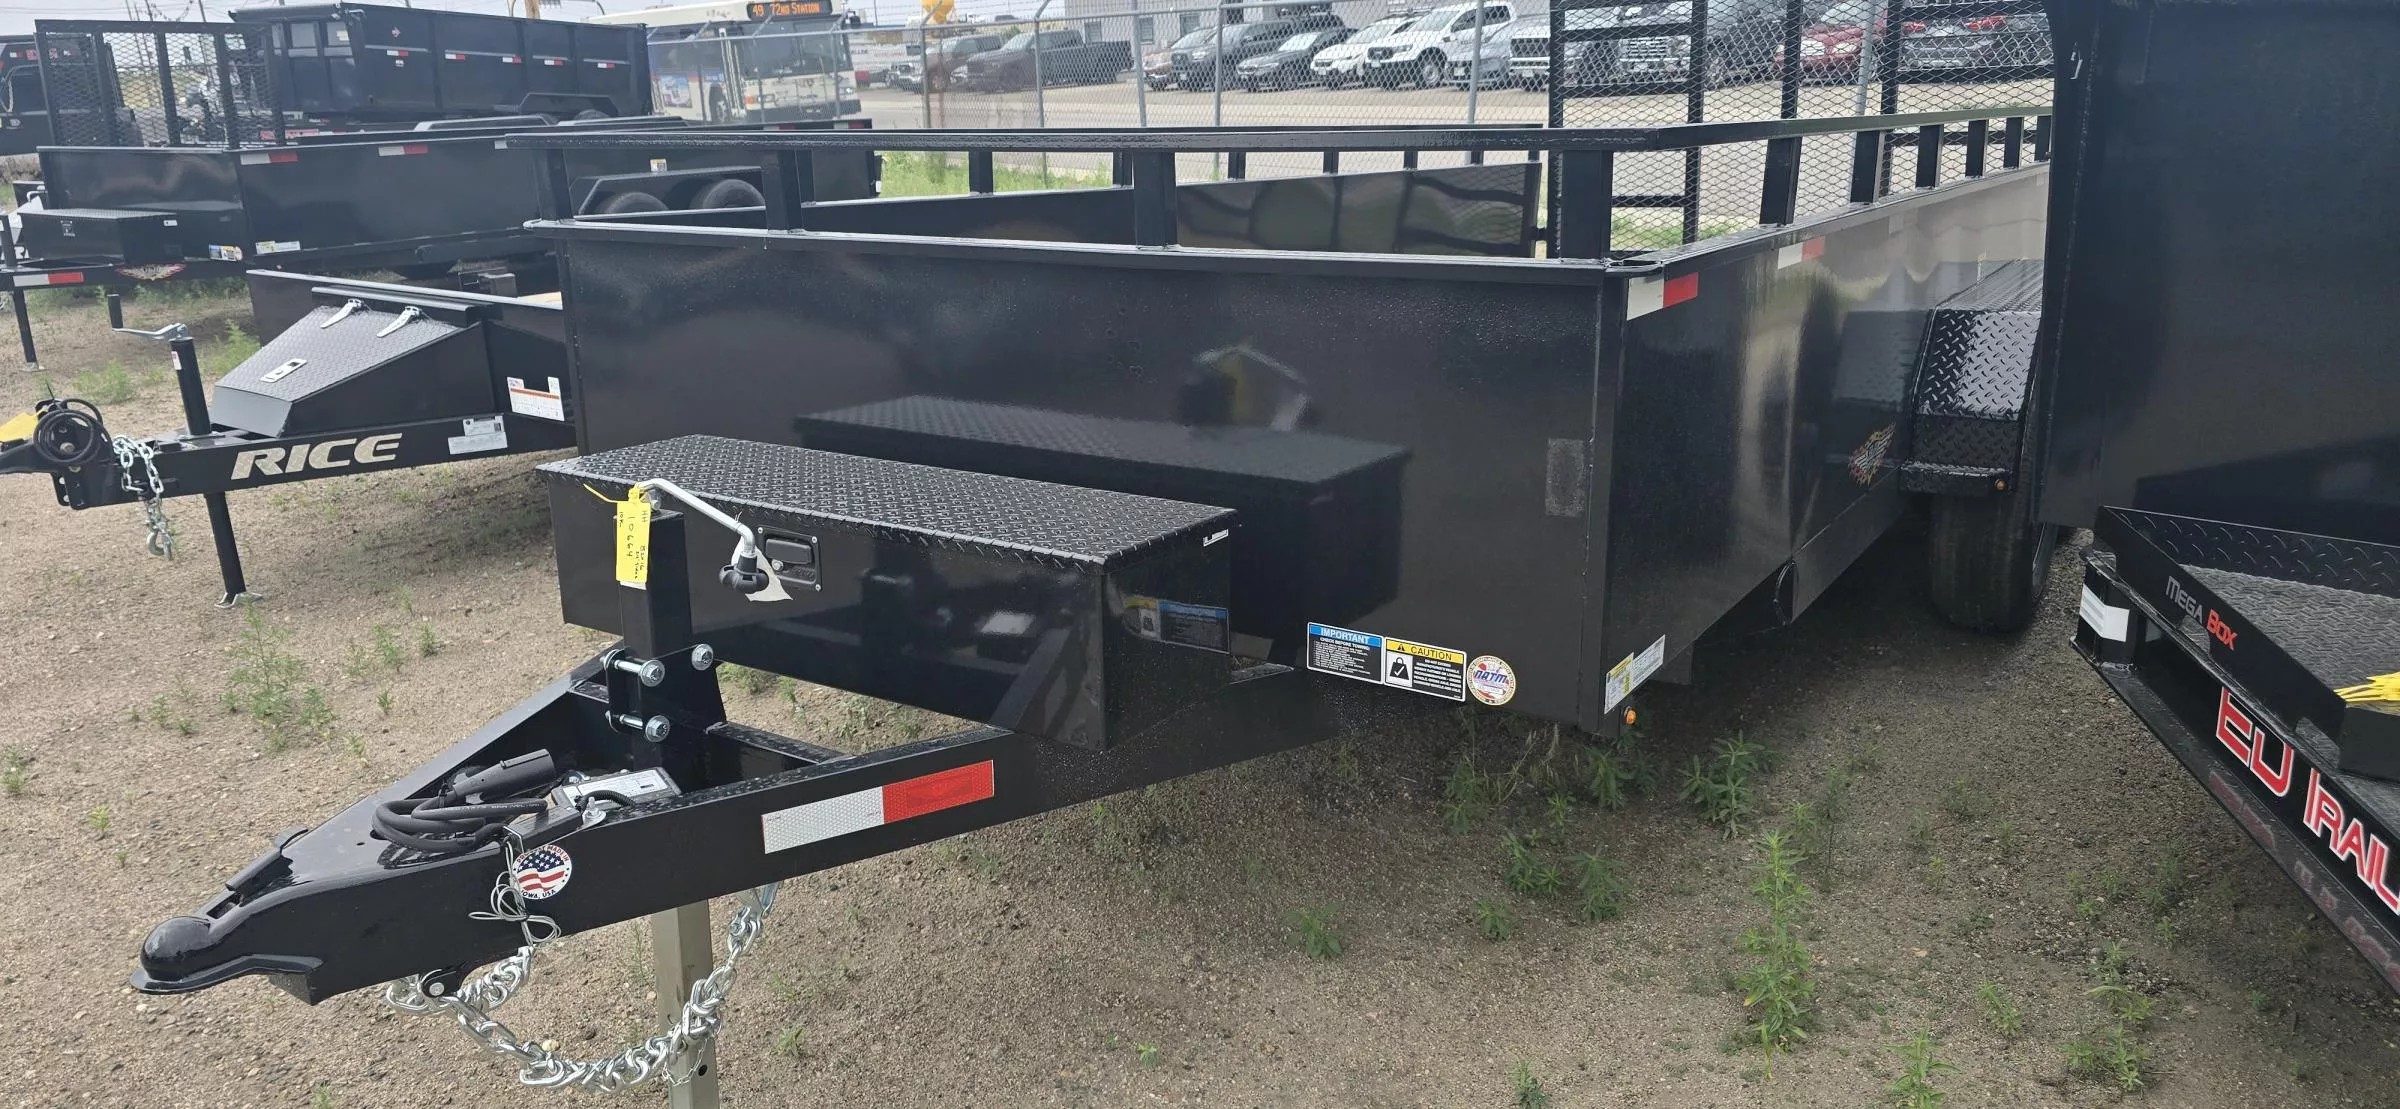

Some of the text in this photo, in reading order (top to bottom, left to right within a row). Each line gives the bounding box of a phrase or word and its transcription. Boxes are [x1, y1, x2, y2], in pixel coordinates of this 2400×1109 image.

[231, 433, 402, 480] RICE
[2166, 575, 2238, 651] MEGA BOX
[1320, 626, 1370, 645] IMPORTANT
[1410, 646, 1452, 660] CAUTION
[542, 889, 556, 897] USA
